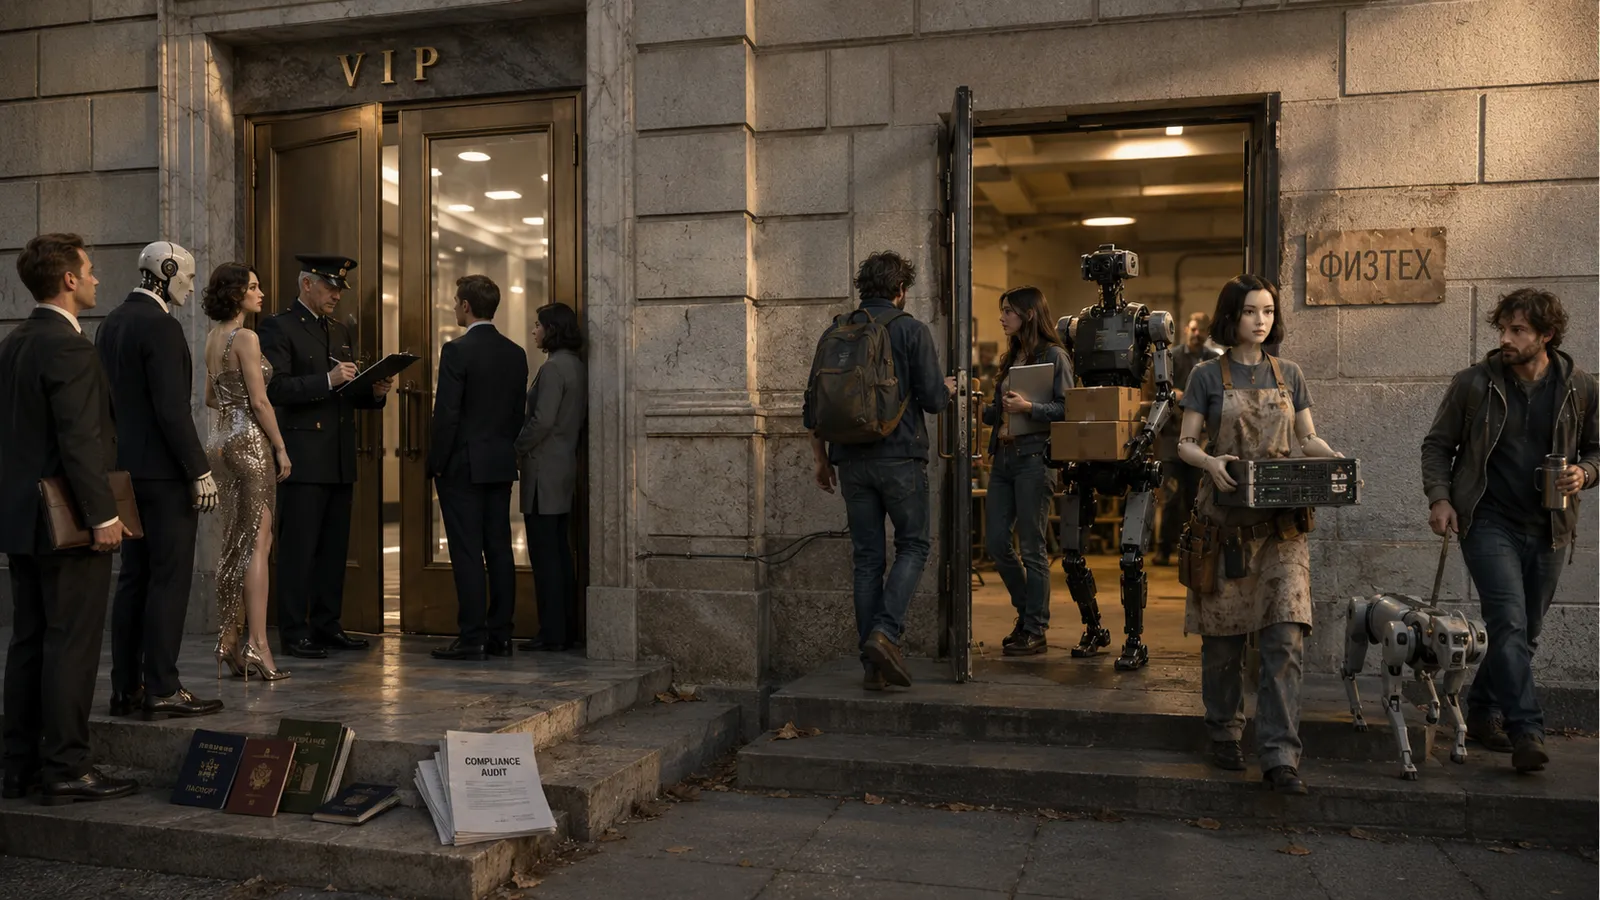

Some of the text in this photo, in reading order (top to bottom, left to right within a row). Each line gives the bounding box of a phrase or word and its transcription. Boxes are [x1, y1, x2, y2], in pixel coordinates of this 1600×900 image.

[337, 46, 438, 88] VIP
[1319, 248, 1432, 282] ФИЗТЕХ
[465, 756, 521, 766] COMPLIANCE
[481, 768, 507, 777] AUDIT
